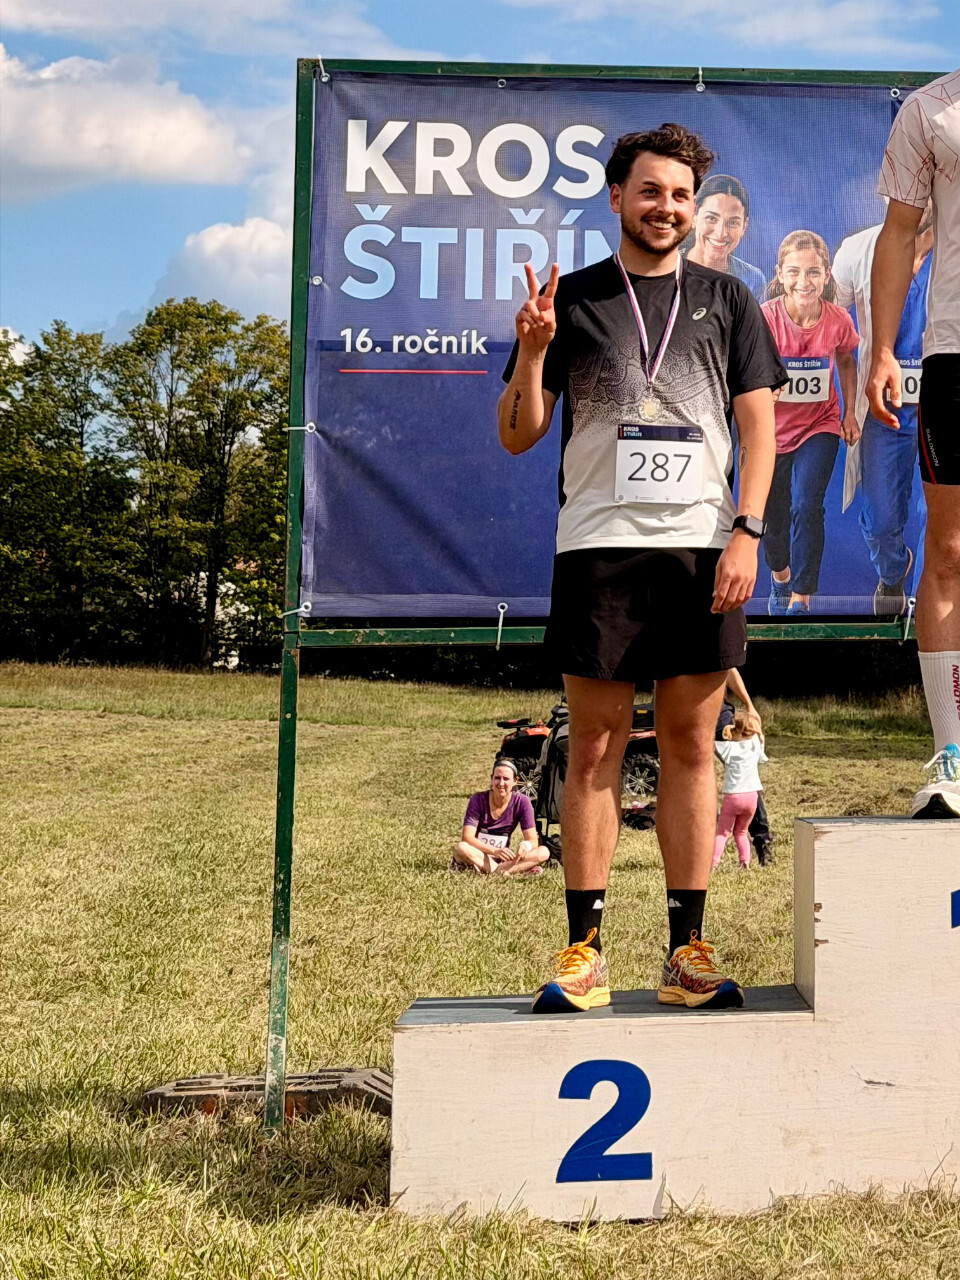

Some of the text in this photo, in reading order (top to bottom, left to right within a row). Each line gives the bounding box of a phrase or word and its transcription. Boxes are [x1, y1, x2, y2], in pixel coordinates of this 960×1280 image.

[345, 119, 607, 200] KROS
[340, 328, 489, 355] 16. ročník
[788, 376, 822, 395] 103
[627, 451, 692, 483] 287
[555, 1058, 653, 1184] 2
